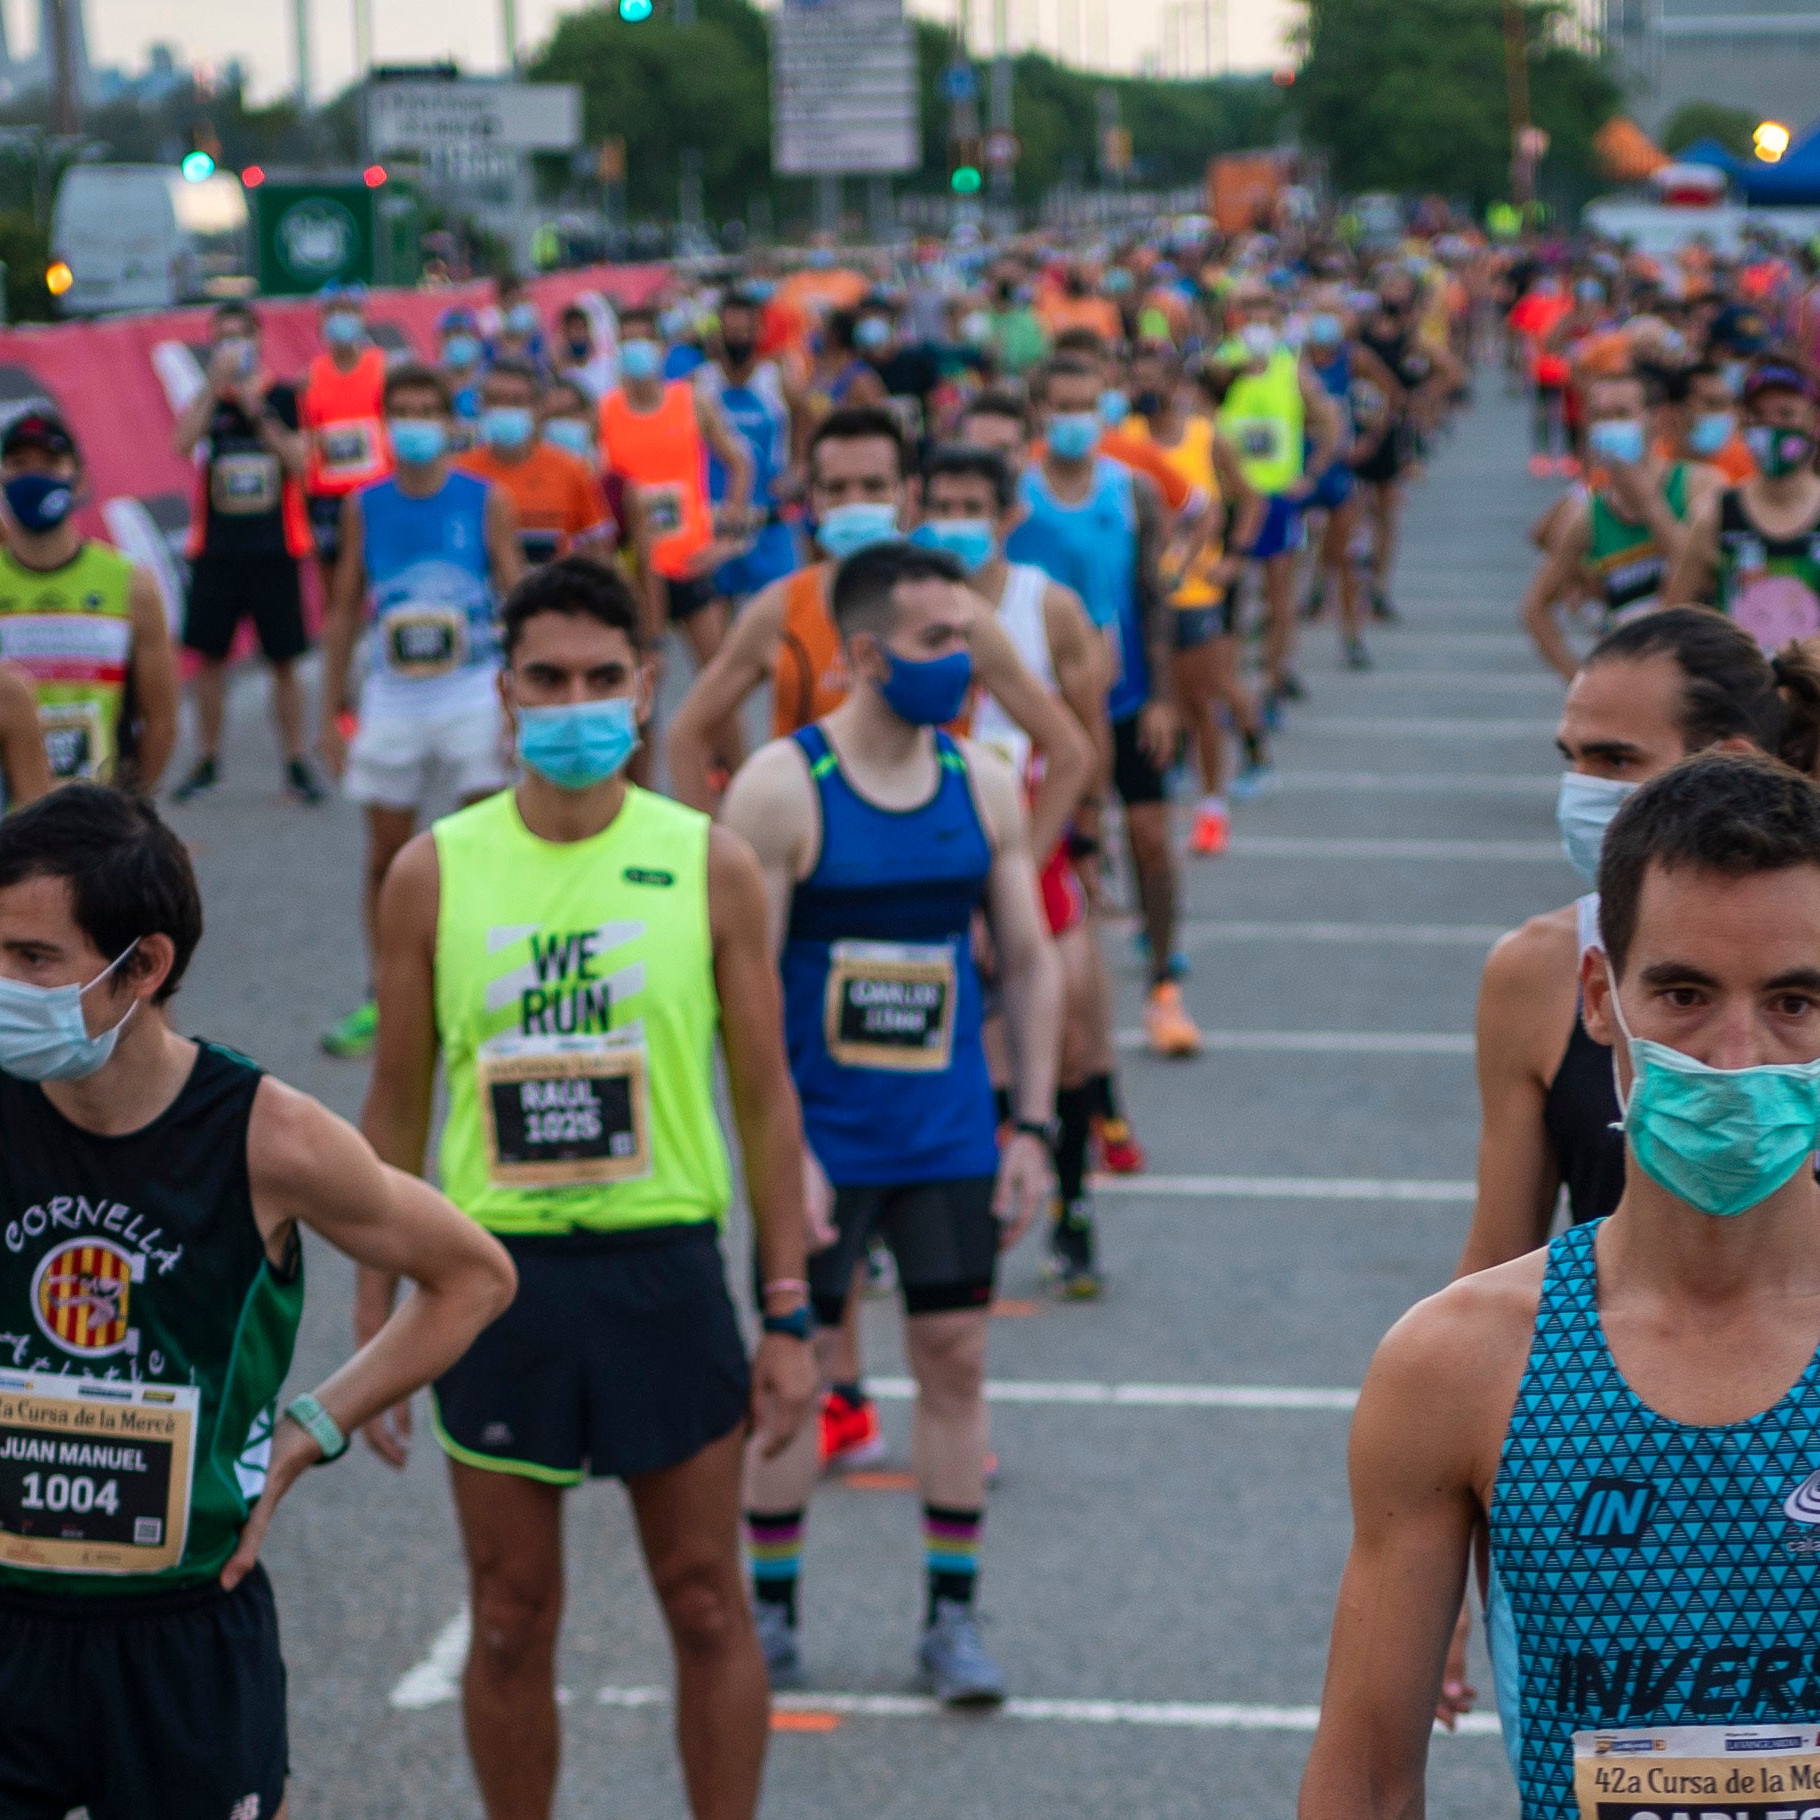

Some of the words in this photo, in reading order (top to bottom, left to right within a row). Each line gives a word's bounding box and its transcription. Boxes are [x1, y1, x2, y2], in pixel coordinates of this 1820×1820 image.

[530, 931, 600, 981] WE
[521, 984, 612, 1036] RUN
[17, 1399, 69, 1425] Cursa
[74, 1407, 95, 1426] de
[99, 1408, 116, 1429] la
[0, 1436, 56, 1465] JUAN
[58, 1442, 148, 1473] MANUEL
[21, 1471, 120, 1516] 1004
[1594, 1767, 1641, 1793] 42a
[1648, 1767, 1718, 1793] Cursa
[1725, 1767, 1755, 1794] de
[1761, 1767, 1784, 1792] la
